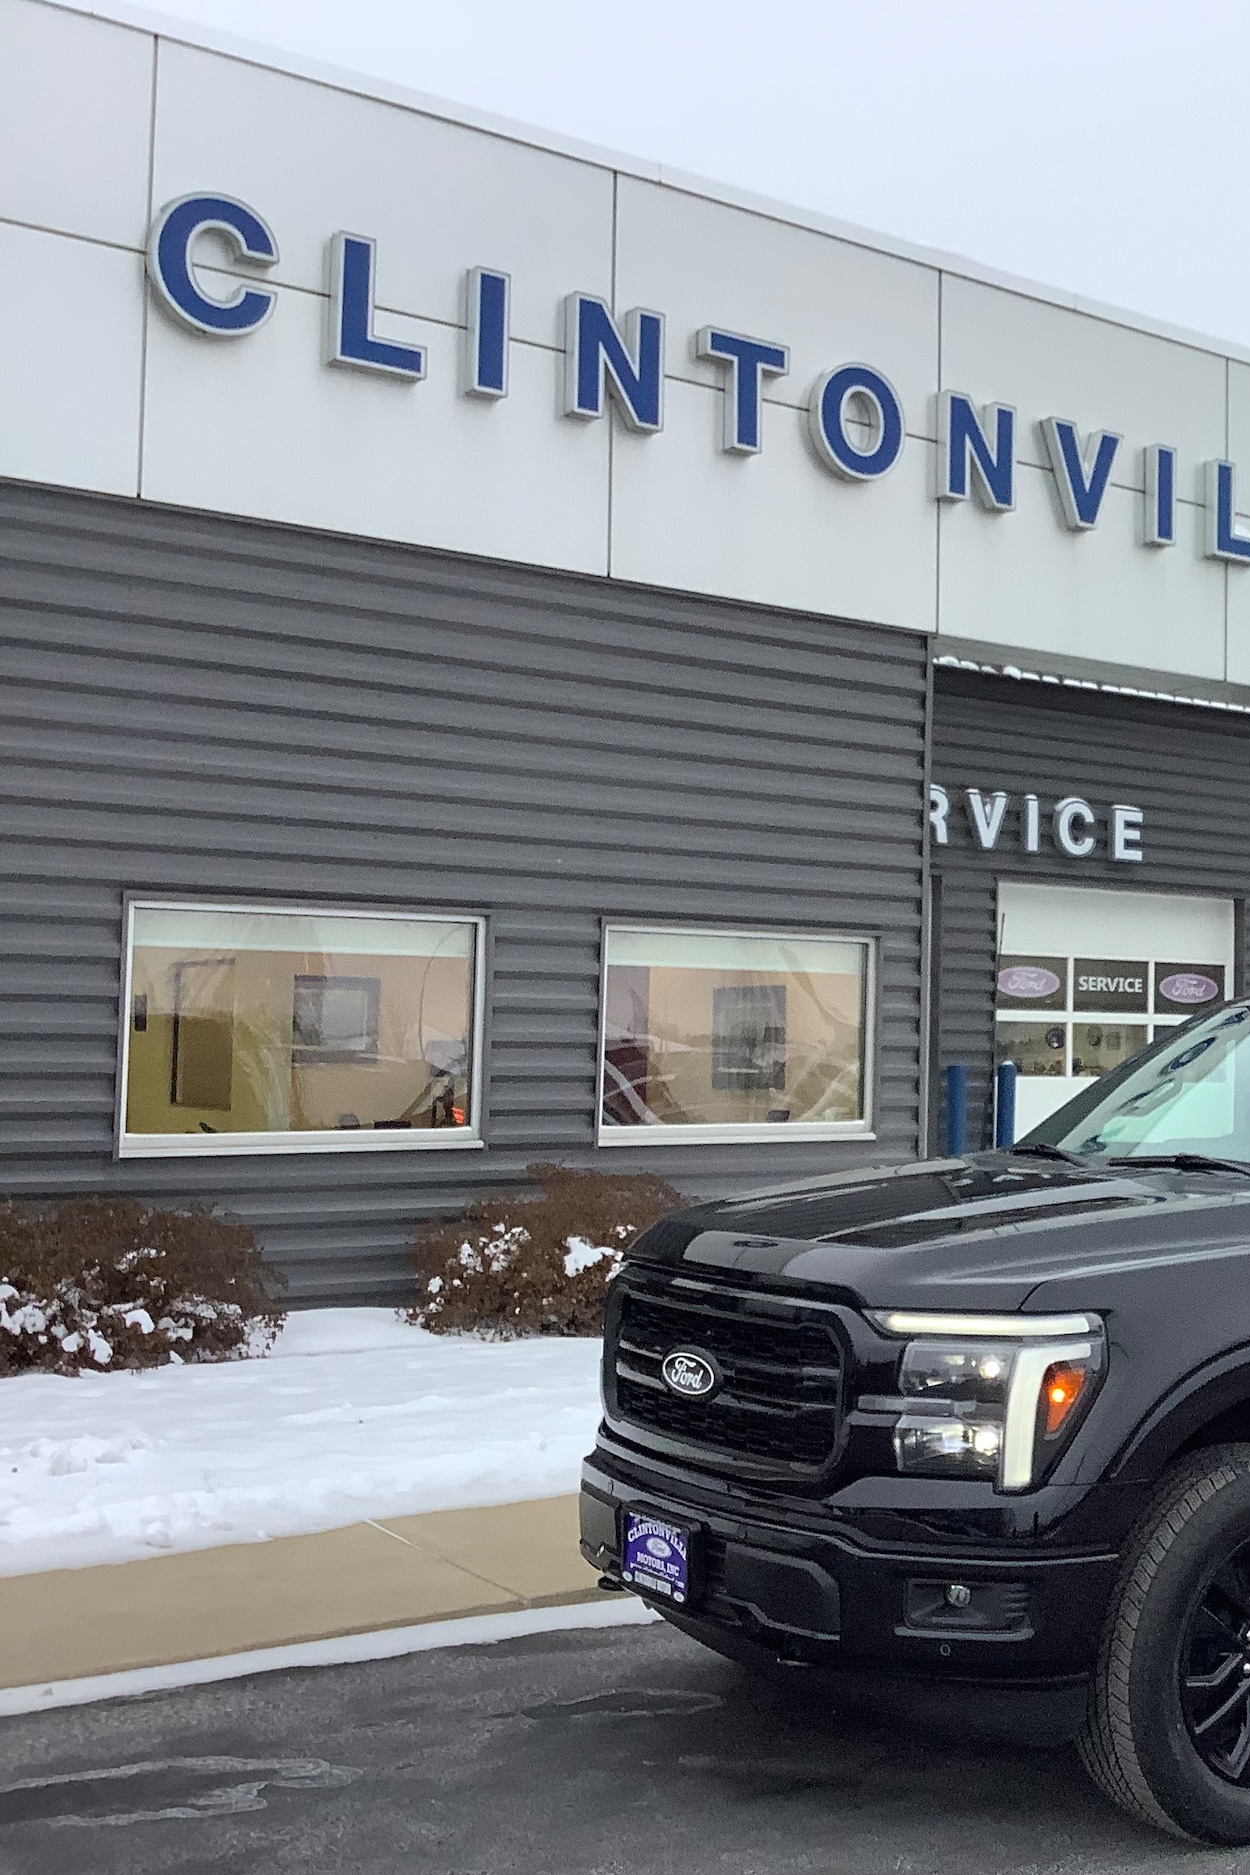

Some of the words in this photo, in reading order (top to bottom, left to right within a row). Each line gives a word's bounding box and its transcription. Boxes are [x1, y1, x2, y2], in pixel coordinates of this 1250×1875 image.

[1008, 971, 1047, 992] Ford
[1078, 976, 1144, 993] SERVICE
[1171, 979, 1207, 997] Ford
[671, 1357, 704, 1389] Ford
